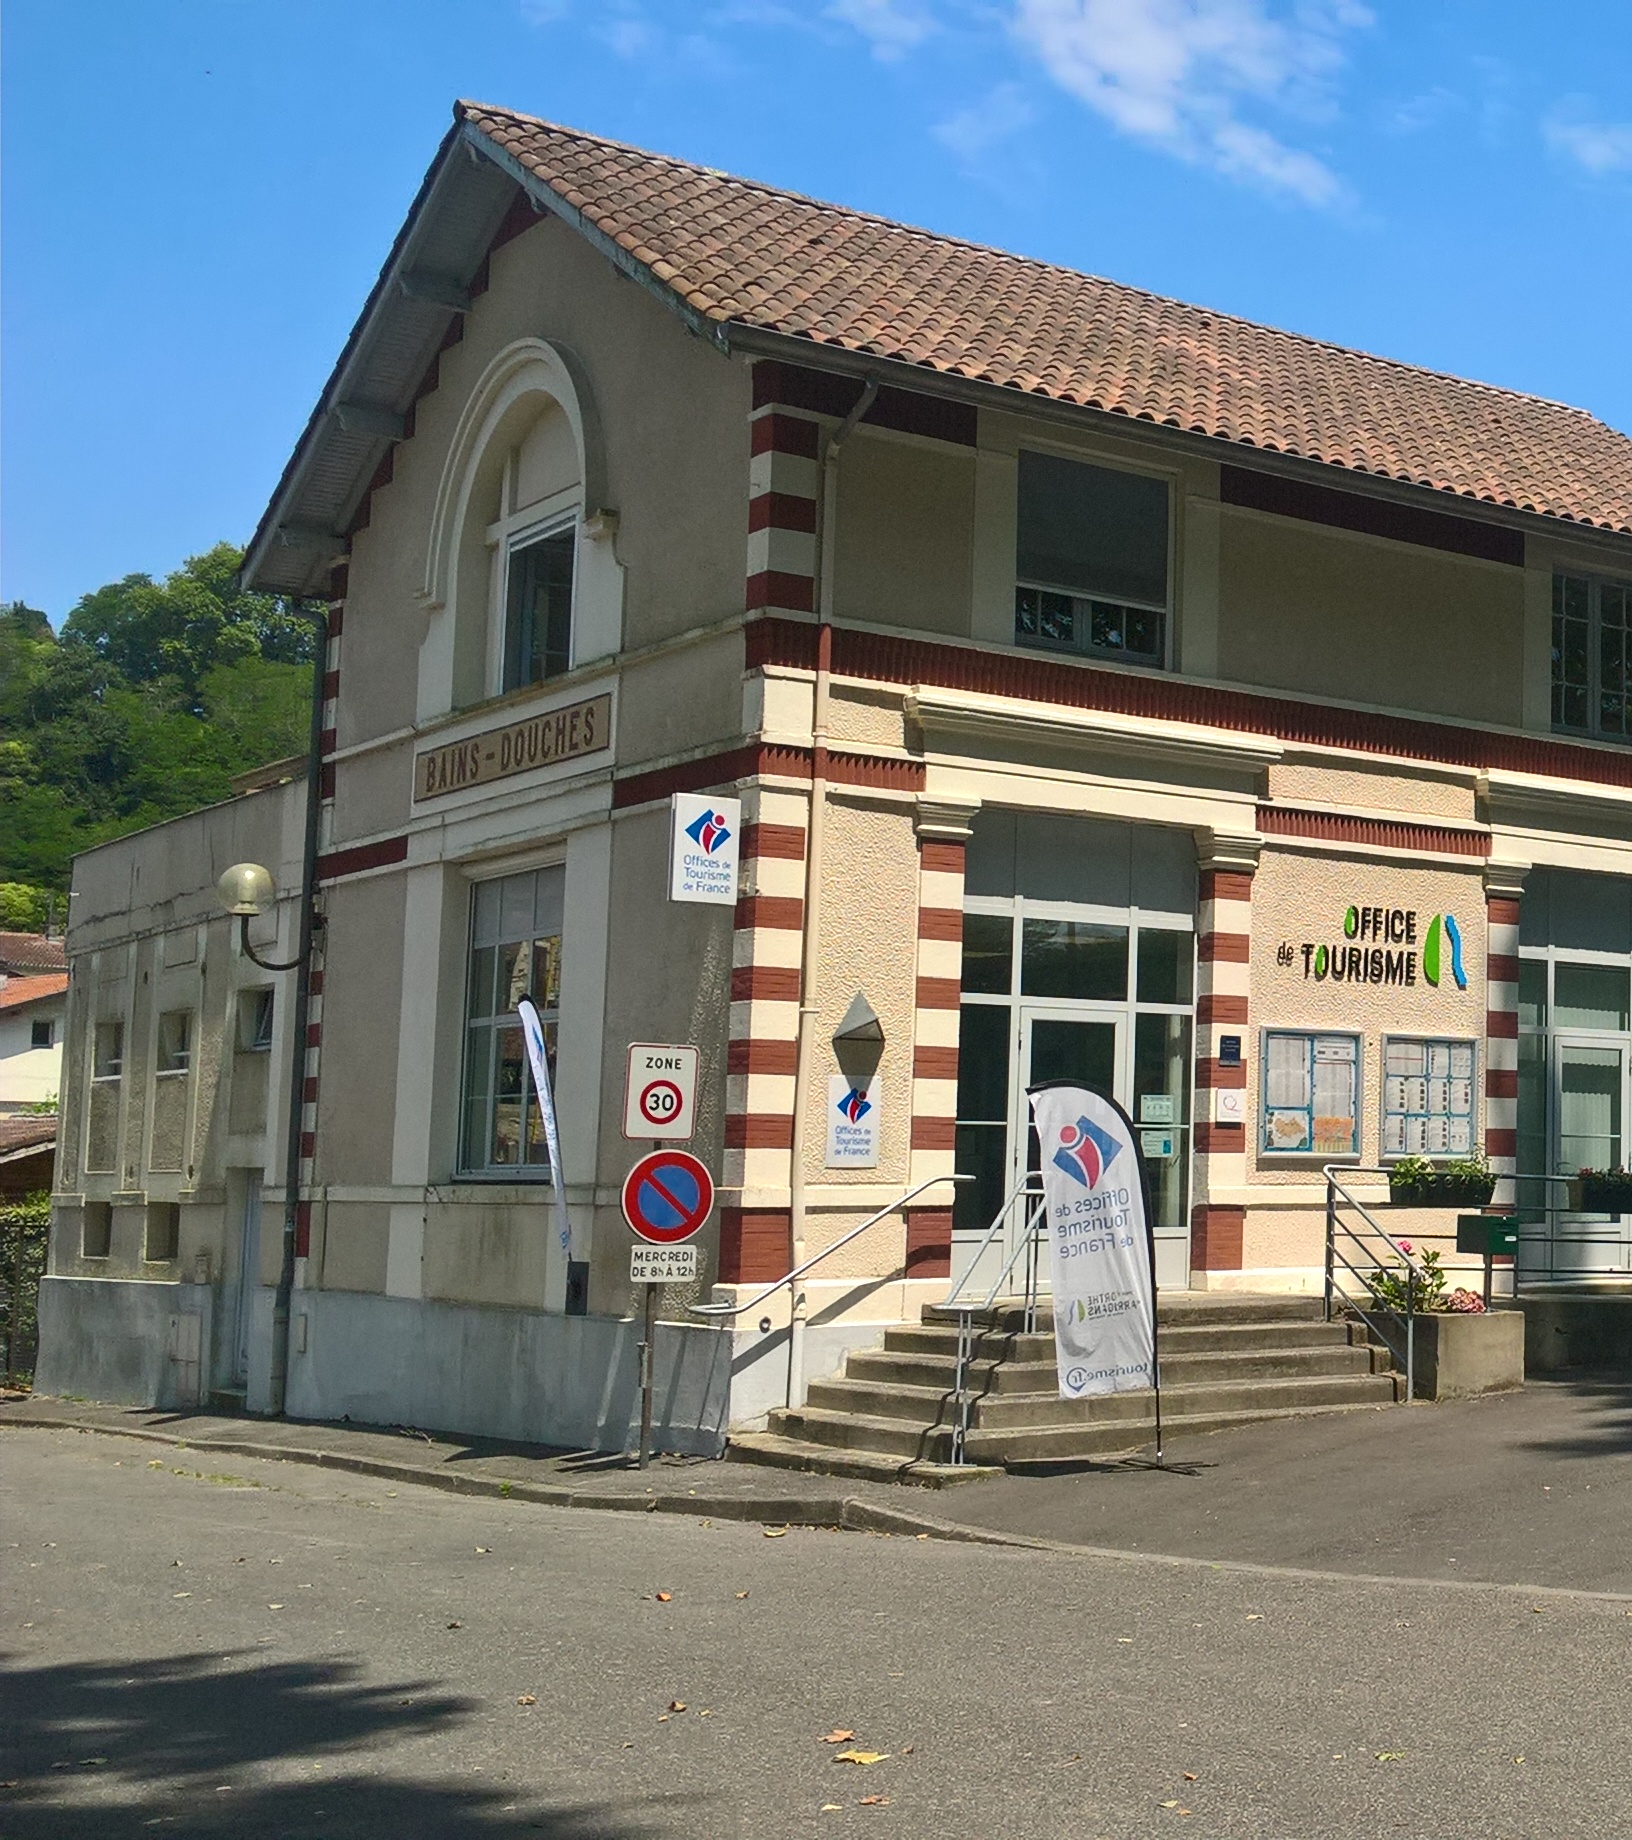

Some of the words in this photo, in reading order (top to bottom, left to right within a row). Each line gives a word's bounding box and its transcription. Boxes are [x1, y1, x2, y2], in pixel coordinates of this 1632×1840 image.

[683, 854, 721, 868] Offices
[722, 860, 731, 869] de
[684, 866, 731, 882] Tourisme
[683, 882, 694, 891] de
[696, 881, 731, 894] France
[1344, 905, 1417, 943] OFFICE
[1277, 941, 1294, 966] de
[1300, 944, 1417, 986] TOURISME
[645, 1057, 683, 1071] ZONE
[648, 1093, 675, 1112] 30
[835, 1125, 862, 1136] Offices
[835, 1135, 871, 1146] Tourisme
[834, 1148, 842, 1156] de
[843, 1146, 871, 1156] France
[633, 1251, 693, 1262] MERCREDI
[632, 1266, 647, 1277] DE
[650, 1266, 664, 1277] 8h
[676, 1266, 694, 1277] 12h
